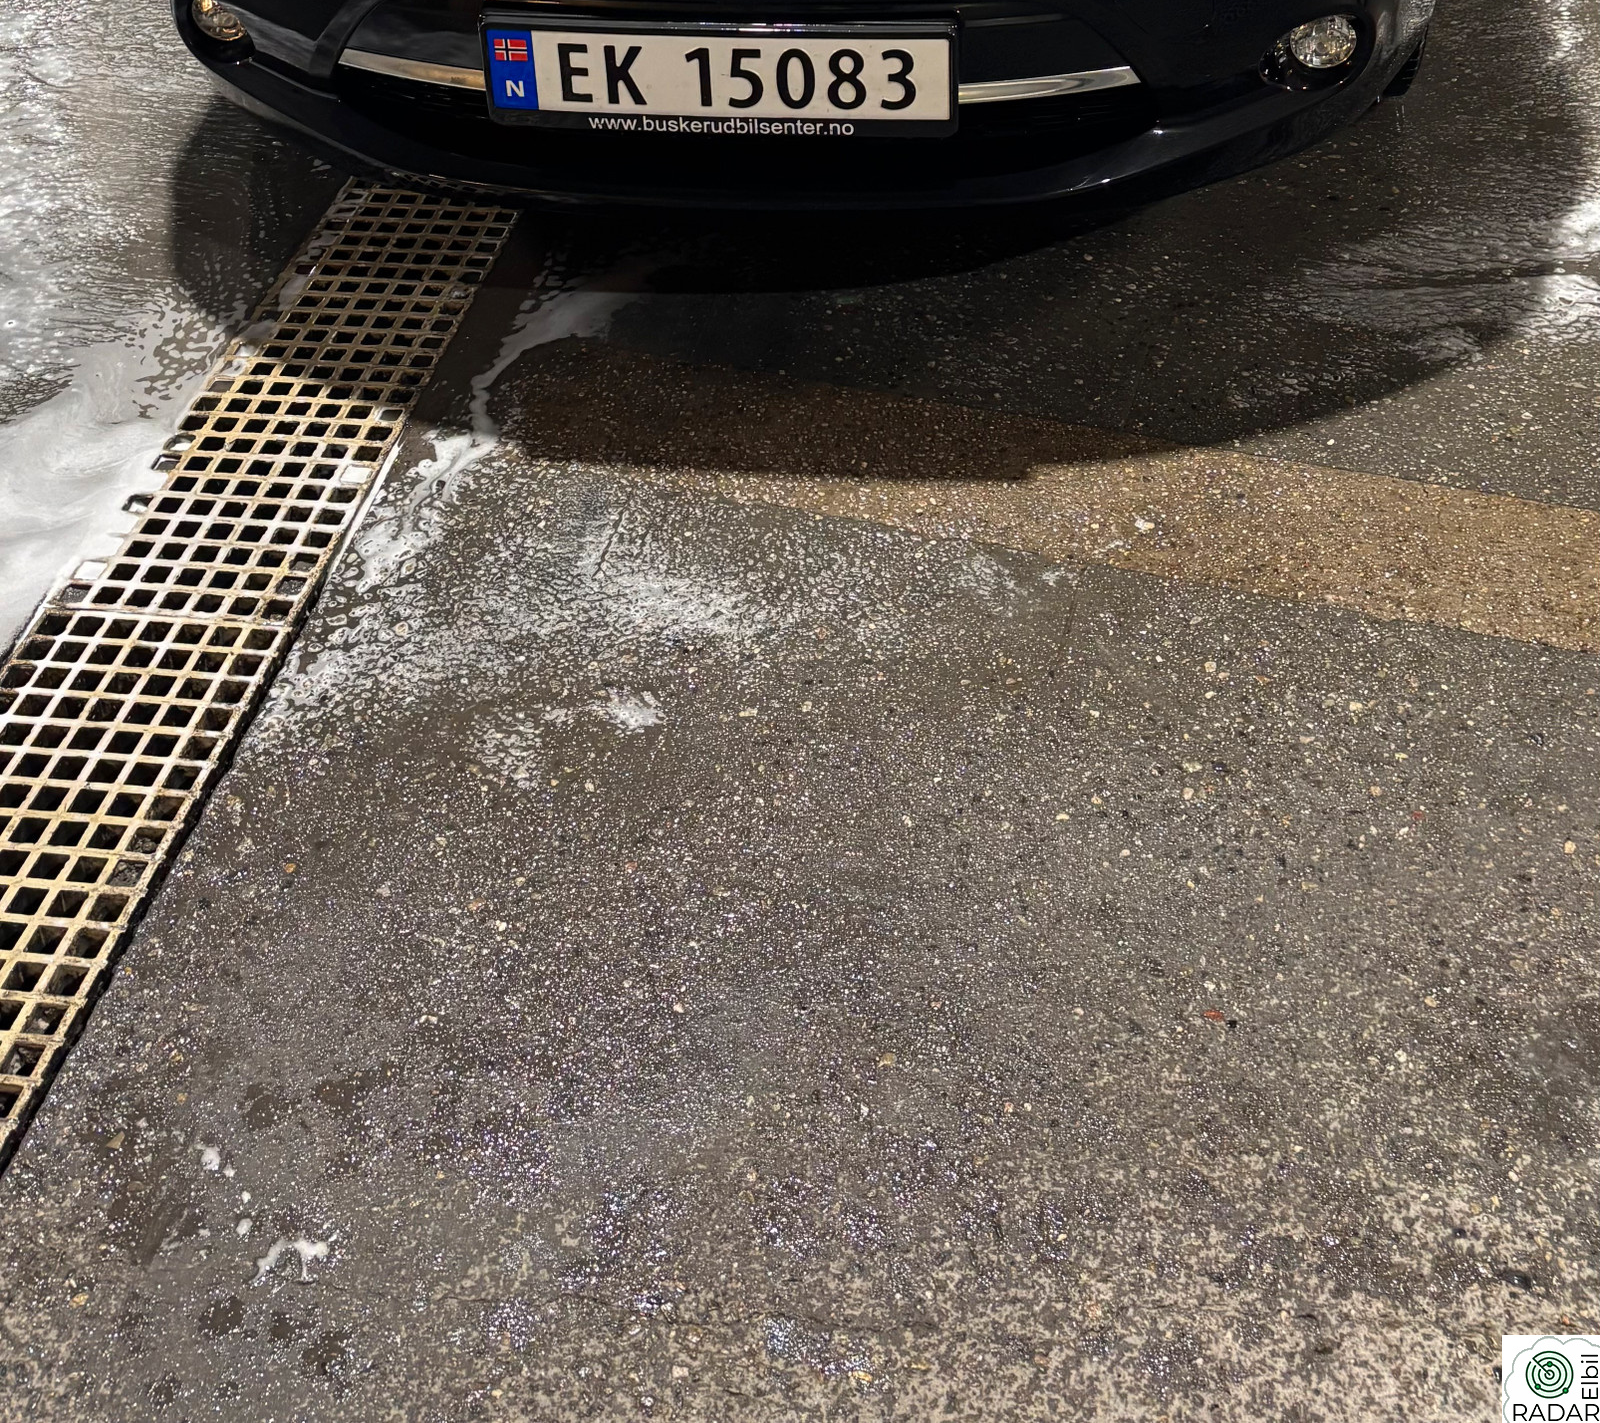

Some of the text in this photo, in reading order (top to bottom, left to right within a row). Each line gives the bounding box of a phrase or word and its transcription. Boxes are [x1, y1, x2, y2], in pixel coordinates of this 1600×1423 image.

[556, 42, 918, 111] EK 15083
[506, 80, 525, 98] N
[588, 114, 855, 137] www.buskerudbilsenter.no
